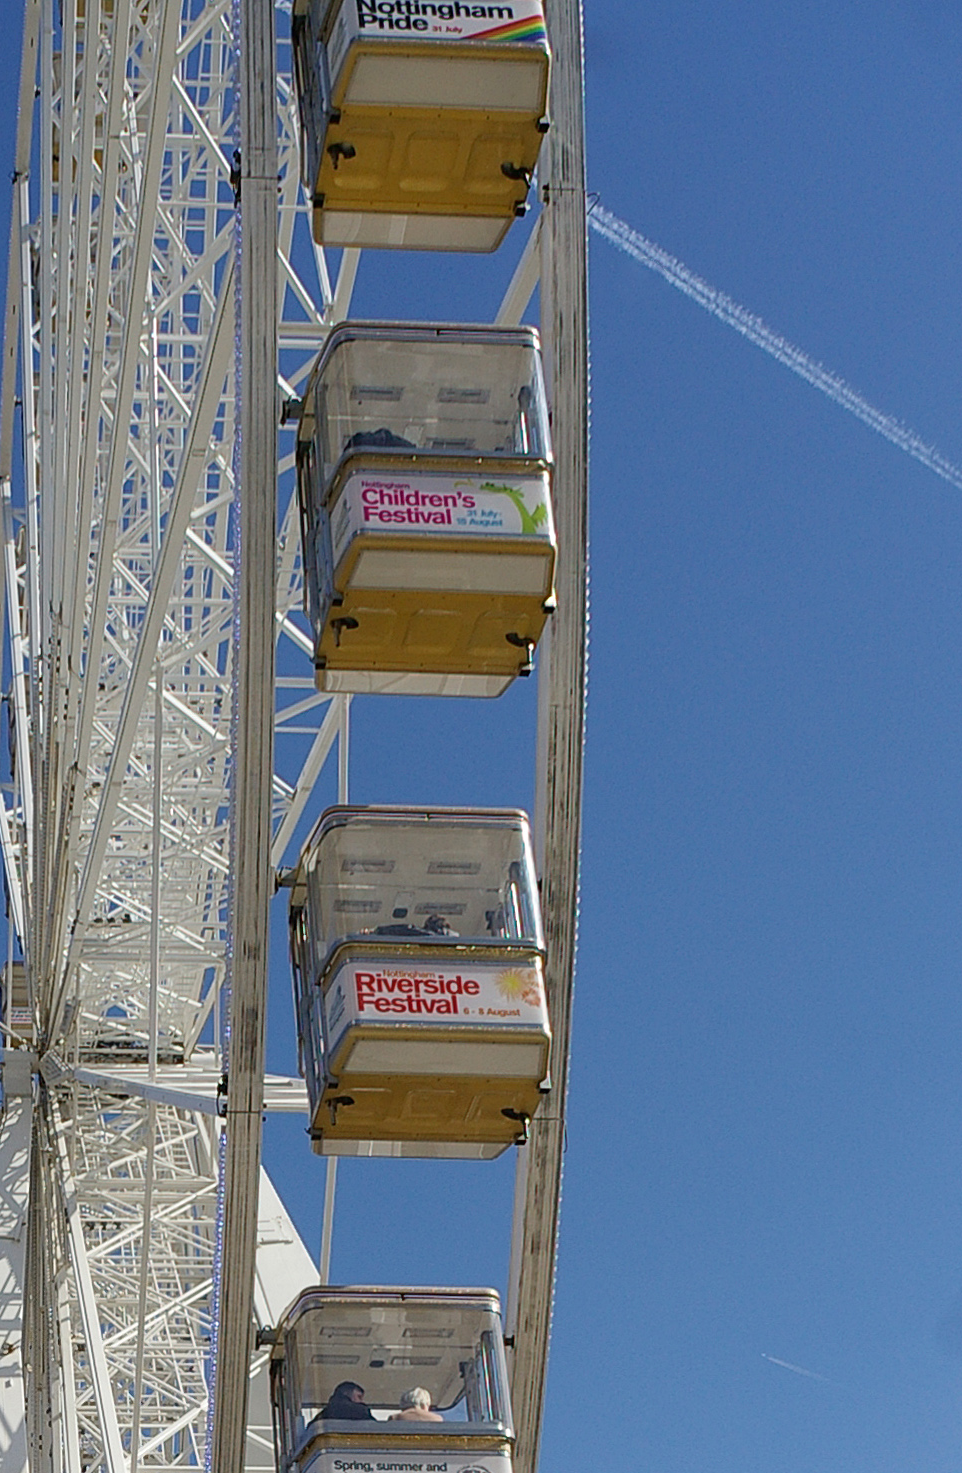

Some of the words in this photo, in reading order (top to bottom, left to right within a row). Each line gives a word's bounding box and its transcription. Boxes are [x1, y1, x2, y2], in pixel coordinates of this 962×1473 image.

[357, 0, 514, 20] Nottingham
[358, 13, 429, 31] Pride
[361, 481, 411, 490] Nottingham
[361, 488, 476, 509] Children's
[363, 506, 453, 525] Festival
[469, 519, 503, 527] August
[383, 969, 436, 979] Nottingham
[355, 973, 480, 996] Riverside
[357, 992, 459, 1015] Festival
[463, 1007, 470, 1015] 6
[478, 1007, 485, 1015] 8
[487, 1008, 521, 1018] August
[334, 1460, 375, 1473] Spring,
[376, 1463, 424, 1472] summer
[426, 1462, 448, 1472] and
